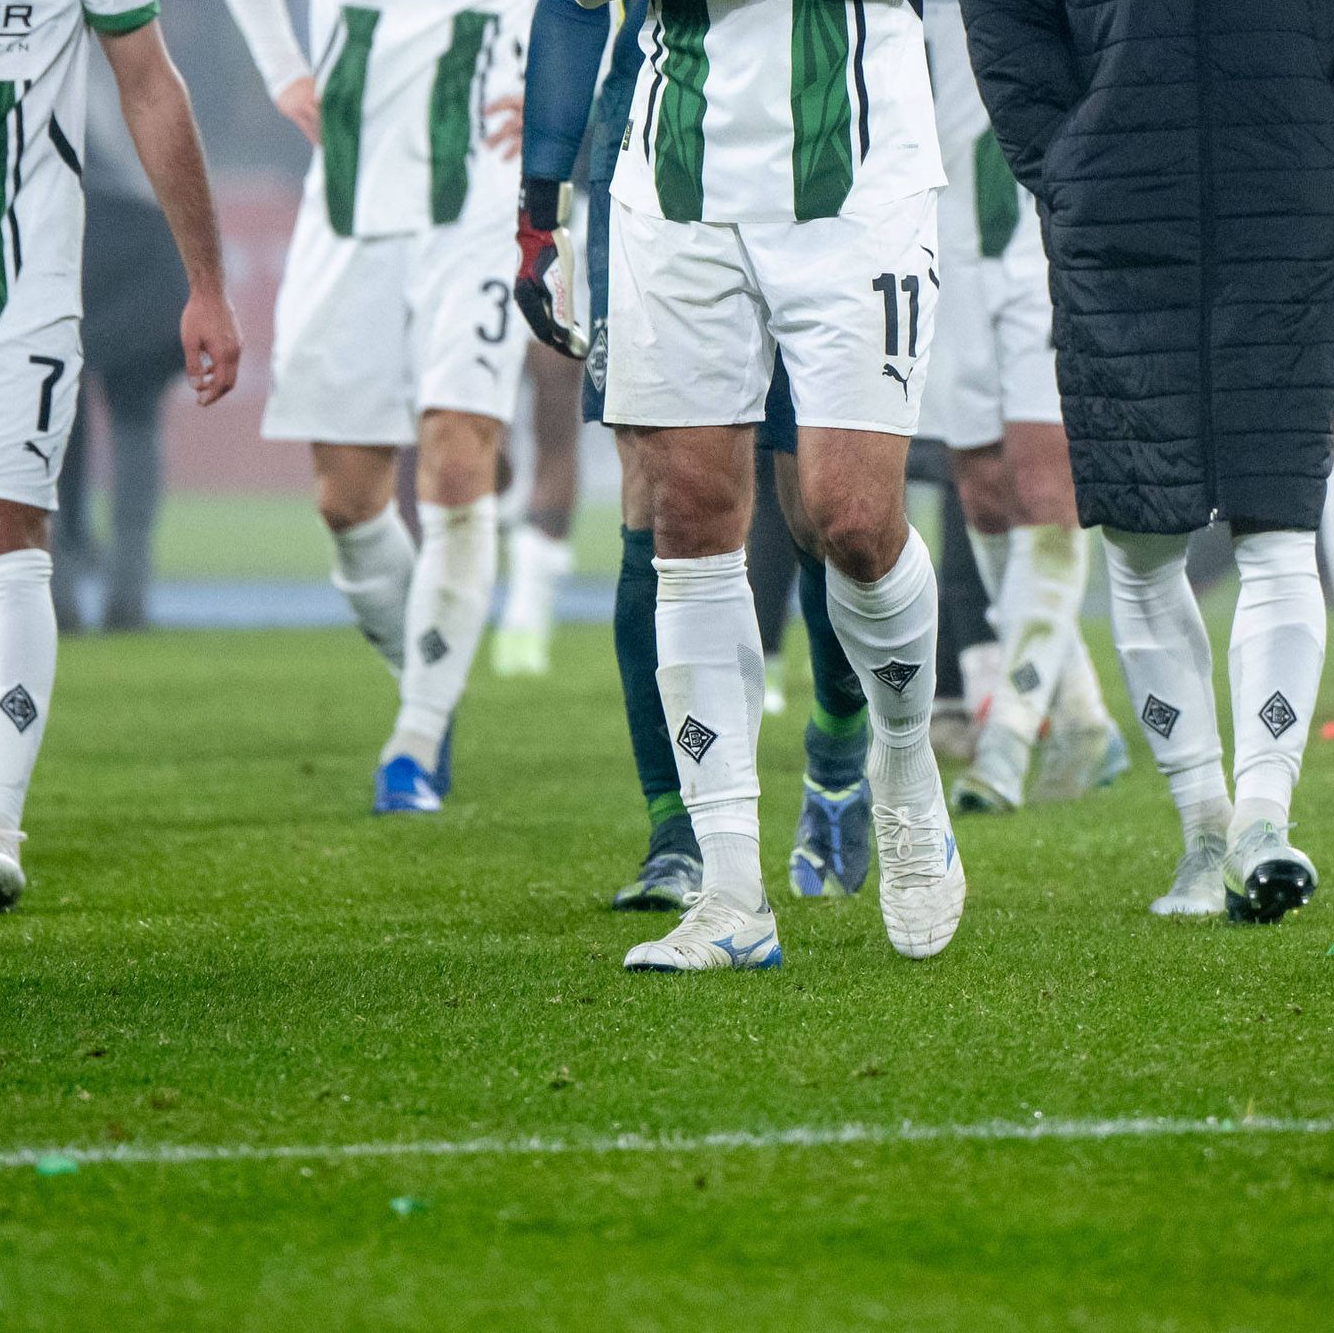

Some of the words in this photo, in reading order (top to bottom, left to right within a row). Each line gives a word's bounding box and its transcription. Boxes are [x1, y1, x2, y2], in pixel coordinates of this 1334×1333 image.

[475, 277, 510, 344] 3
[872, 272, 919, 359] 11
[28, 354, 65, 433] 7
